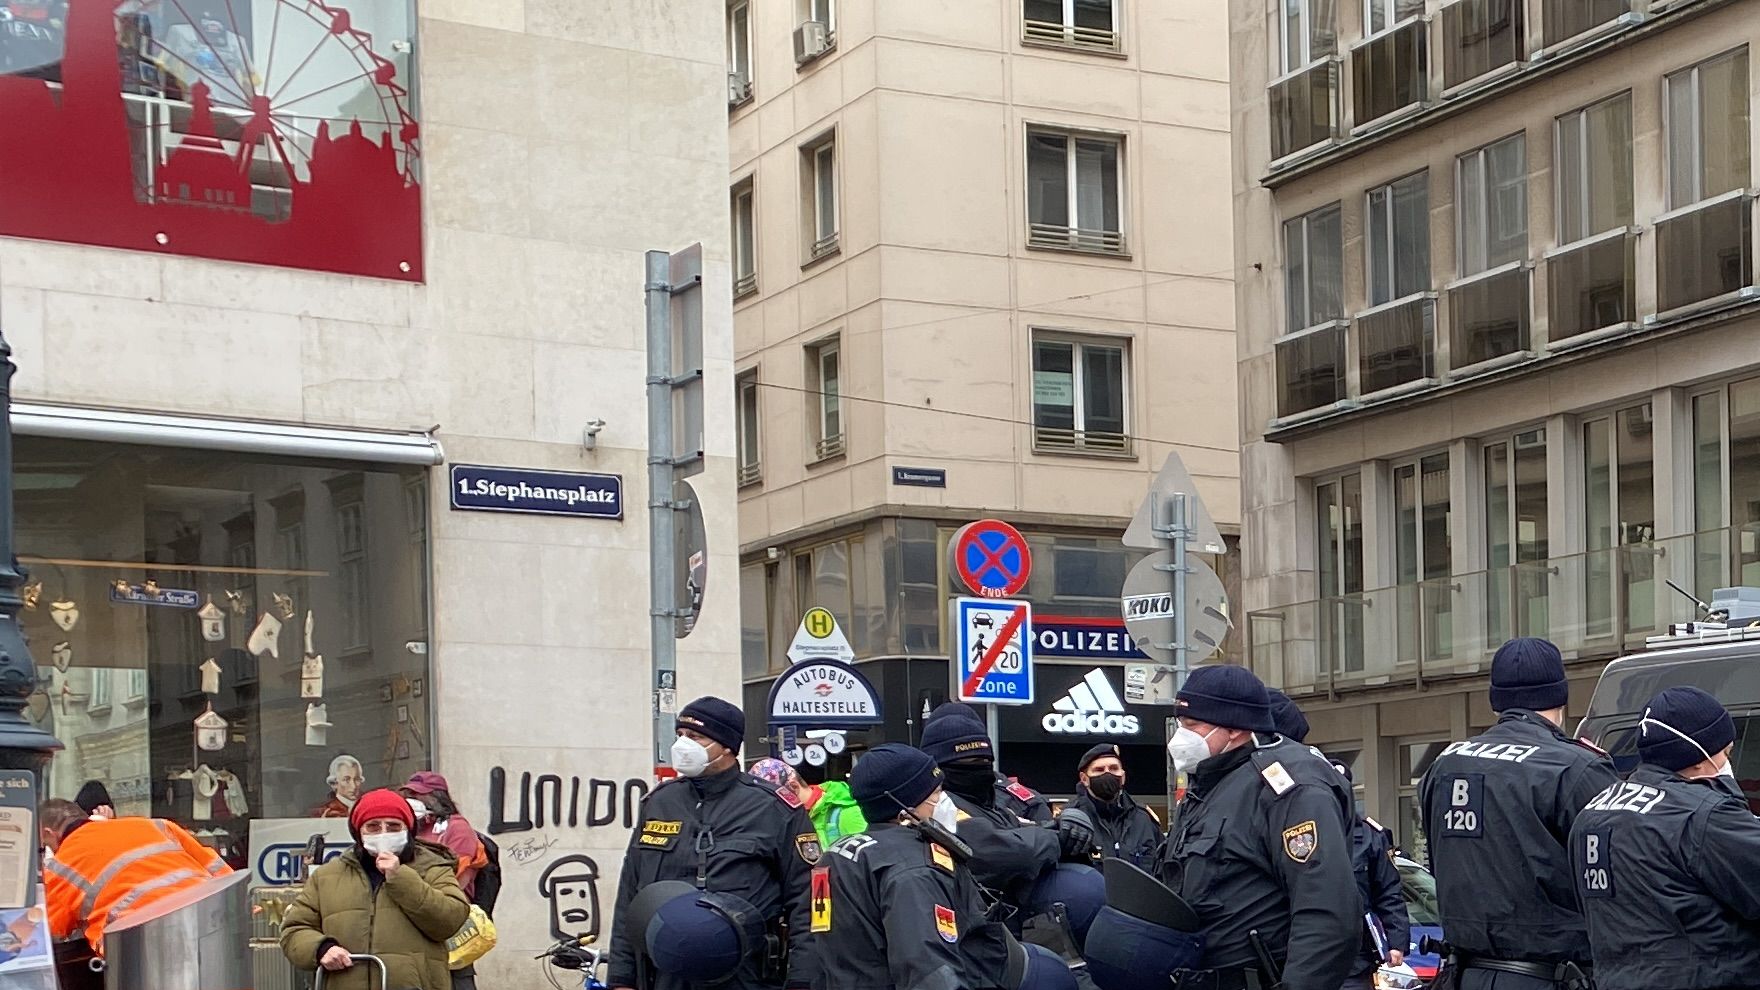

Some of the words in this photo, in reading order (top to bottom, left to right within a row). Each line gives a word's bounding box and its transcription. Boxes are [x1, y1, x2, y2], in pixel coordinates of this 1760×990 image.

[980, 585, 1009, 598] ENDE
[812, 614, 827, 634] H
[1000, 651, 1019, 669] 20
[793, 668, 855, 690] AUTOBUS
[975, 677, 1017, 694] Zone
[783, 701, 867, 714] HALTESTELLE
[1042, 709, 1140, 733] adidas
[1436, 741, 1541, 763] OLIZEI
[1452, 779, 1469, 806] B
[1584, 782, 1666, 815] OLIZEI
[1444, 809, 1477, 831] 120
[1586, 834, 1599, 864] B
[1584, 868, 1608, 889] 120
